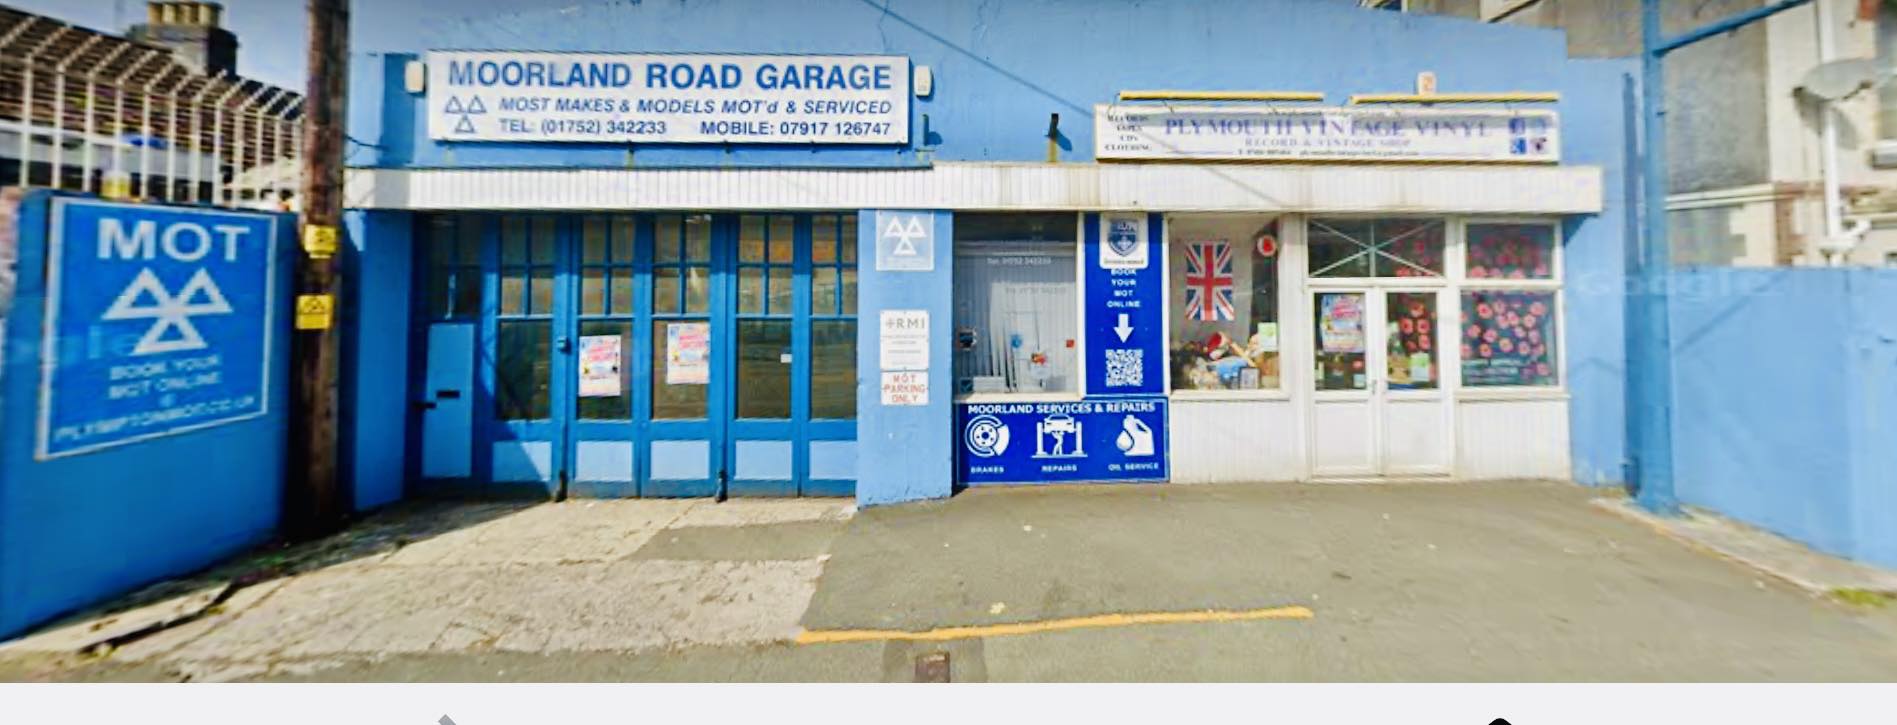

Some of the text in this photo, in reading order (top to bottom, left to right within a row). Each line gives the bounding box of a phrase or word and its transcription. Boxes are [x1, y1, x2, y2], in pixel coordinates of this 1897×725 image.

[448, 60, 892, 90] MOORLAND ROAD GARAGE
[499, 97, 893, 114] MOST MAKES & MODELS MOT'd & SERVICED
[499, 118, 891, 135] TEL: (01752) 342233 MOBILE: 07917 126747
[1165, 116, 1487, 137] PLYMOUTH VINTAGE VINYL
[1245, 138, 1297, 148] RECORD
[1316, 138, 1375, 148] VINTAGE
[97, 217, 250, 262] MOT
[1111, 278, 1137, 287] YOUR
[1113, 289, 1133, 297] MOT
[1106, 300, 1141, 308] ONLINE
[893, 374, 917, 383] MOT
[884, 384, 926, 393] PARKING
[892, 394, 918, 403] ONLY
[968, 401, 1156, 415] MOORLAND SERVICES & REPAIRS
[970, 465, 1005, 474] BRAKES
[1041, 464, 1078, 473] REPAIRS
[1108, 462, 1159, 472] OIL SERVICE
